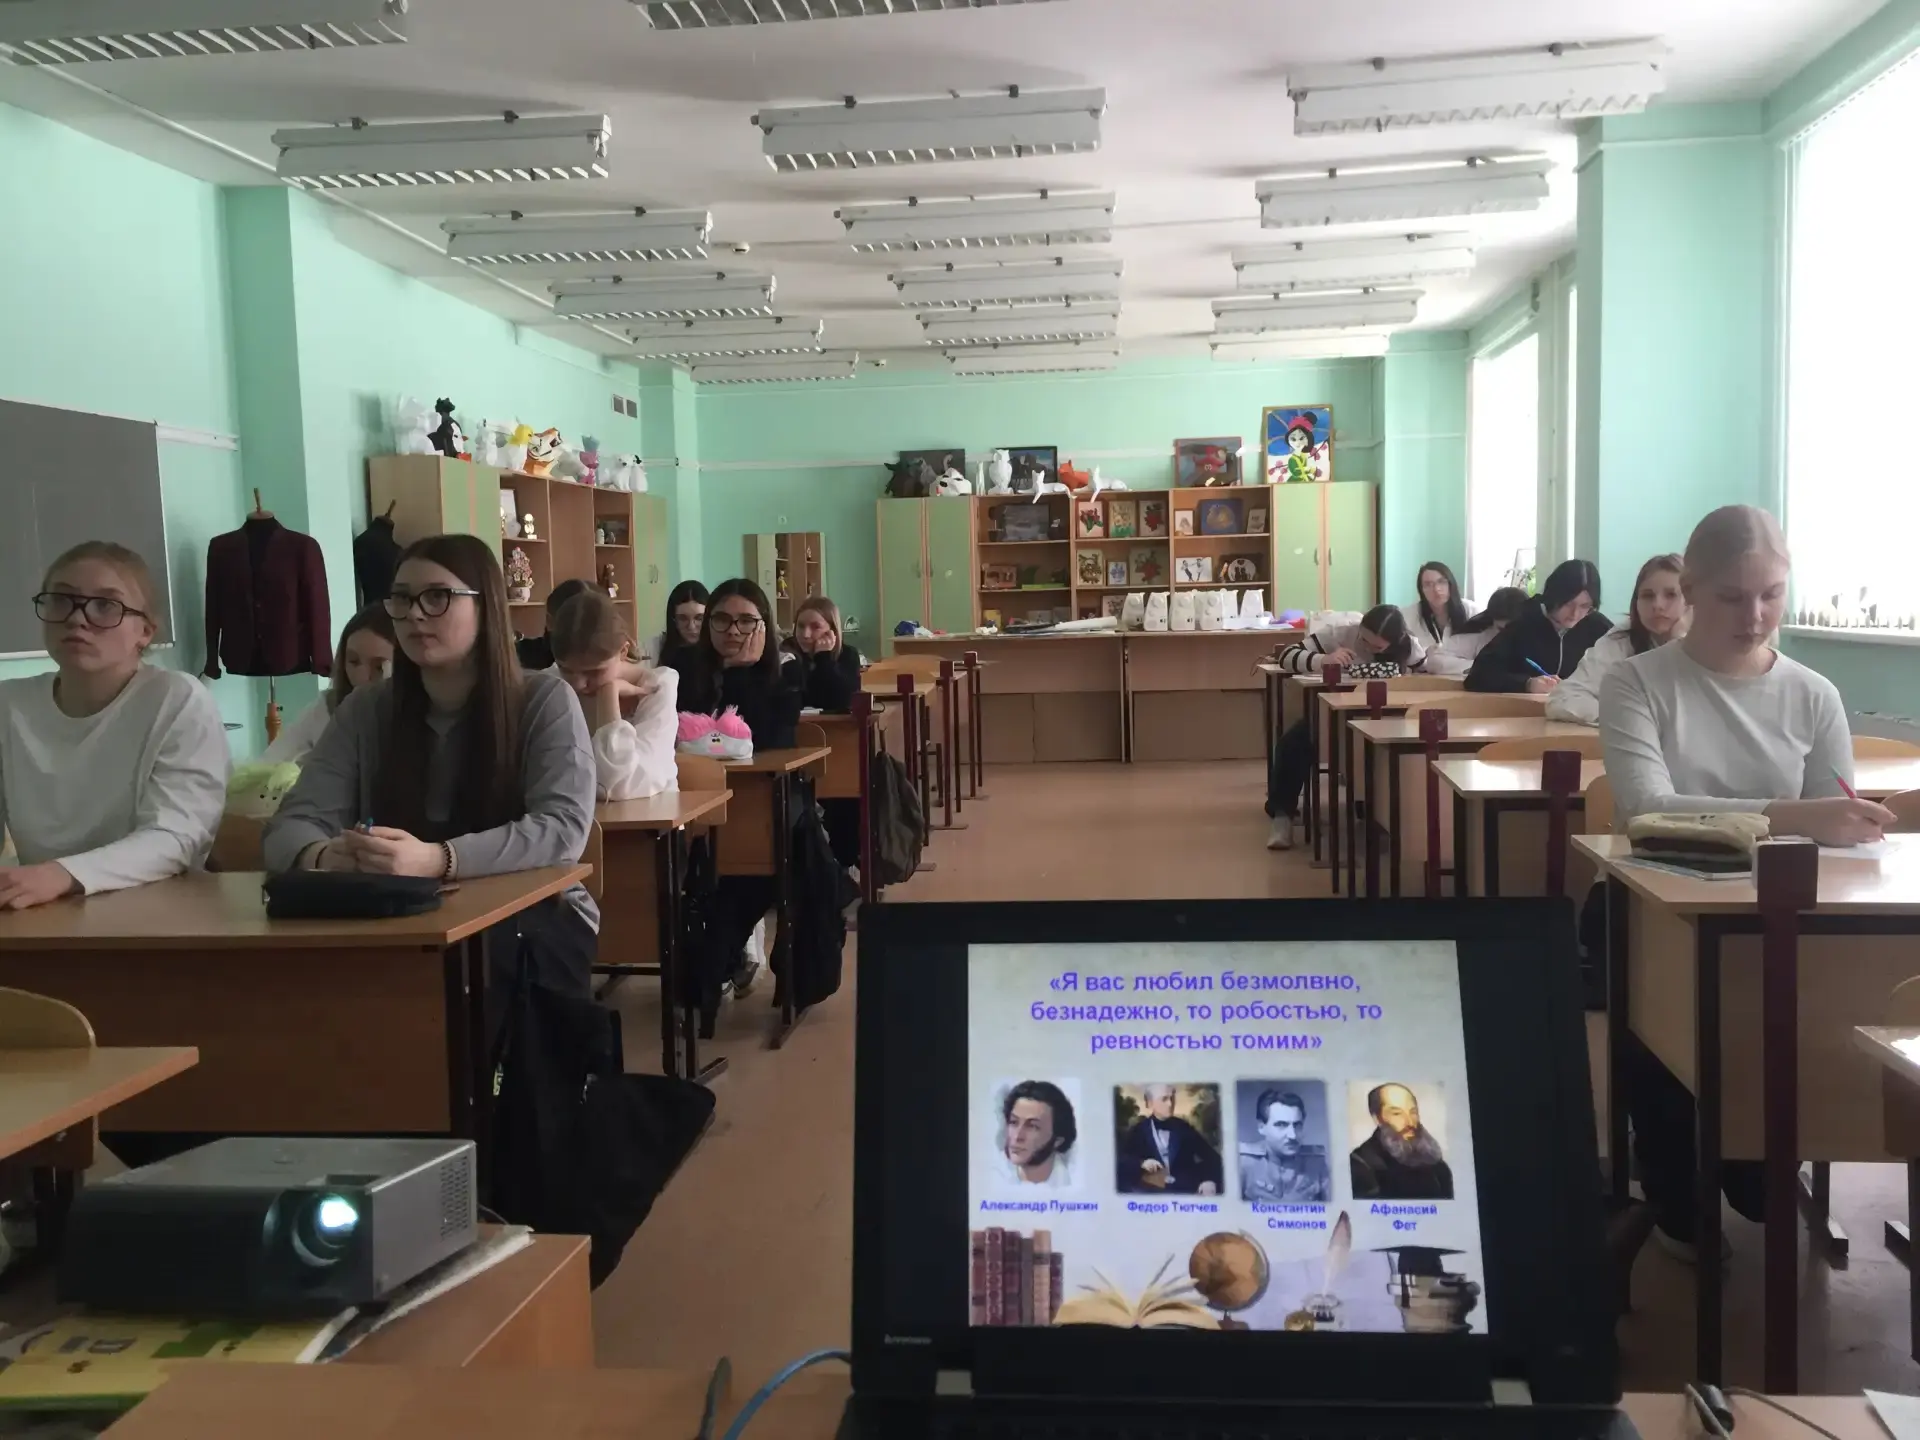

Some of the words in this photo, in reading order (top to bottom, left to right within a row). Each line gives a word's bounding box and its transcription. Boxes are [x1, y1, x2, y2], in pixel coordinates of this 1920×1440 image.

[1050, 972, 1078, 991] «Я
[1085, 975, 1125, 991] вас
[1133, 971, 1213, 991] любил
[1221, 971, 1361, 993] безмолвно,
[1031, 1001, 1180, 1023] безнадежно,
[1187, 1004, 1212, 1020] то
[1221, 1001, 1347, 1024] робостью,
[1356, 1004, 1382, 1020] то
[1091, 1033, 1223, 1055] ревностью
[1231, 1034, 1322, 1050] томим»
[980, 1200, 1048, 1213] Александр
[1050, 1200, 1098, 1212] Пушкин
[1127, 1201, 1169, 1213] Федор
[1172, 1201, 1219, 1213] Тютчев
[1252, 1202, 1327, 1214] Константин
[1370, 1203, 1437, 1216] Афанасий
[1267, 1218, 1326, 1230] Симонов
[1392, 1219, 1418, 1231] Фет
